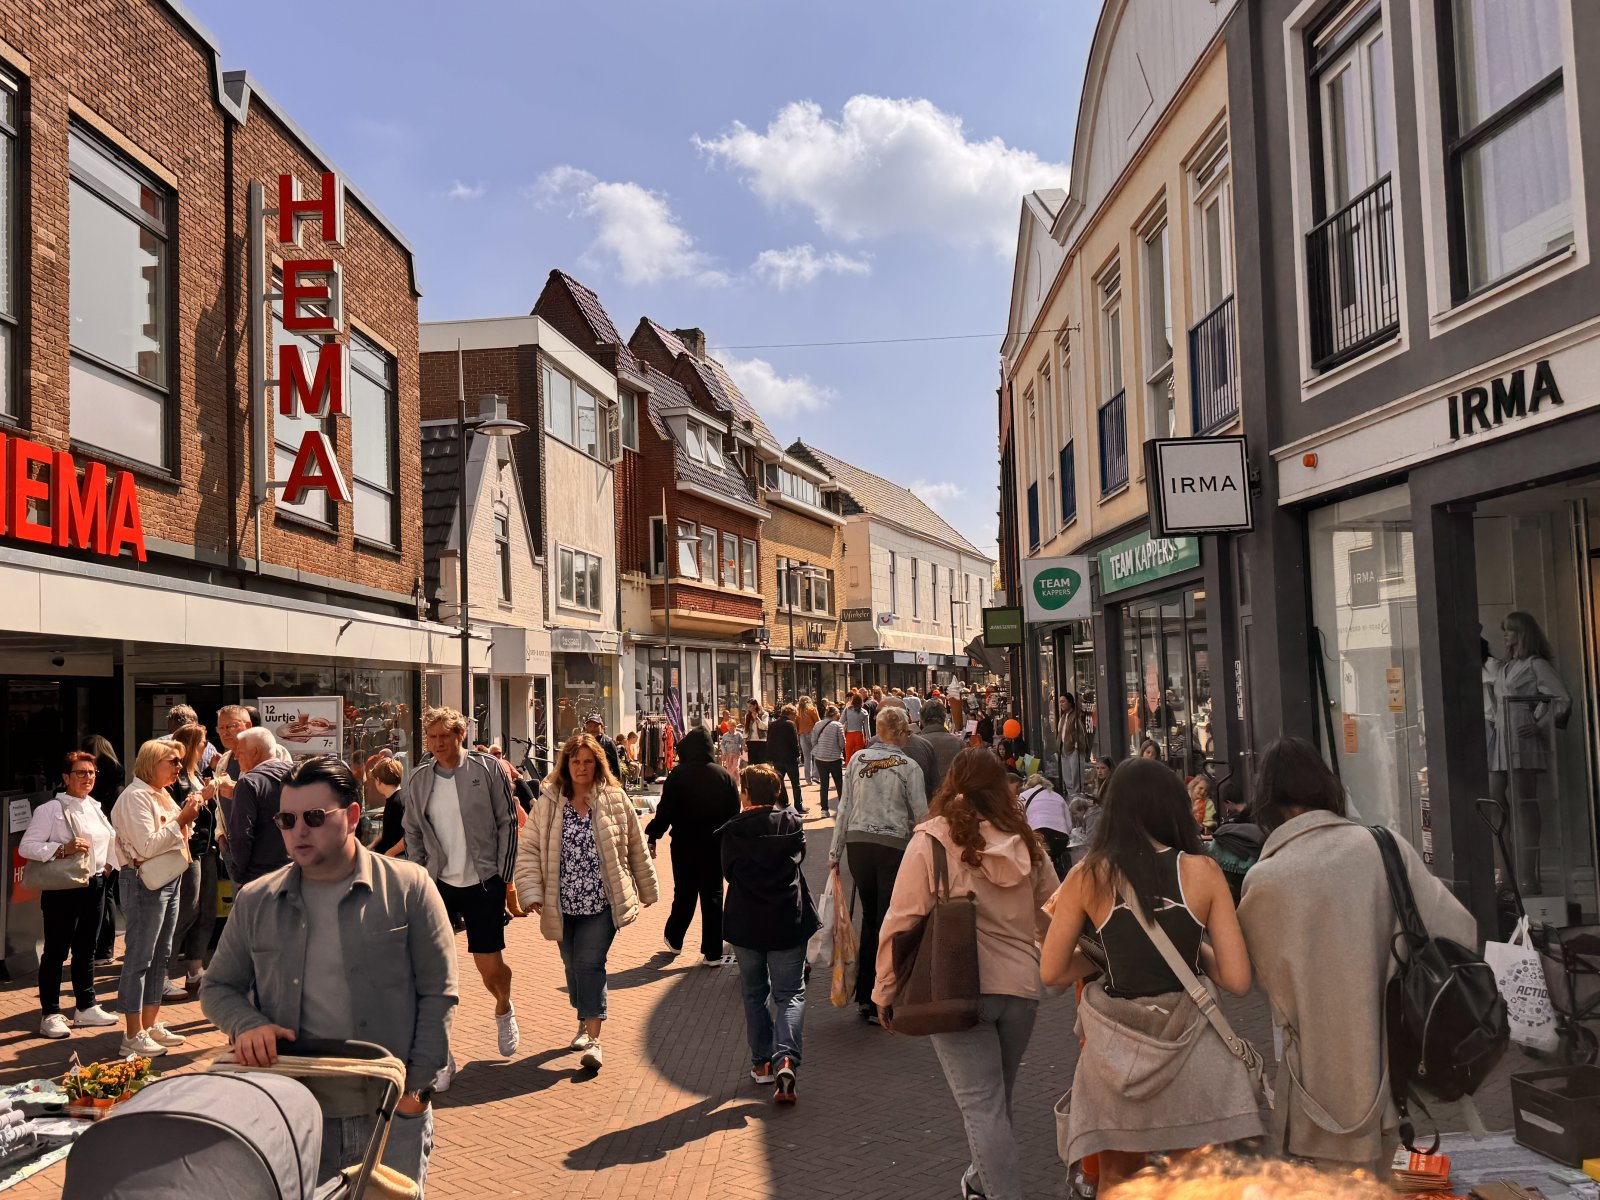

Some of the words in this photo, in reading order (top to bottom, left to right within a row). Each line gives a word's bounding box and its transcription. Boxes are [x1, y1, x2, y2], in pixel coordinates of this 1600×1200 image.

[278, 172, 351, 503] HEMA
[1447, 360, 1564, 440] IRMA
[1171, 475, 1237, 494] IRMA
[1110, 549, 1134, 580] TEAM
[1135, 539, 1175, 572] KAPPERS
[1039, 578, 1070, 588] TEAM
[1353, 570, 1375, 585] IRMA
[1042, 588, 1071, 597] KAPPERS
[265, 705, 275, 714] 12
[265, 713, 296, 724] uurtje
[1516, 985, 1549, 999] ACTIO
